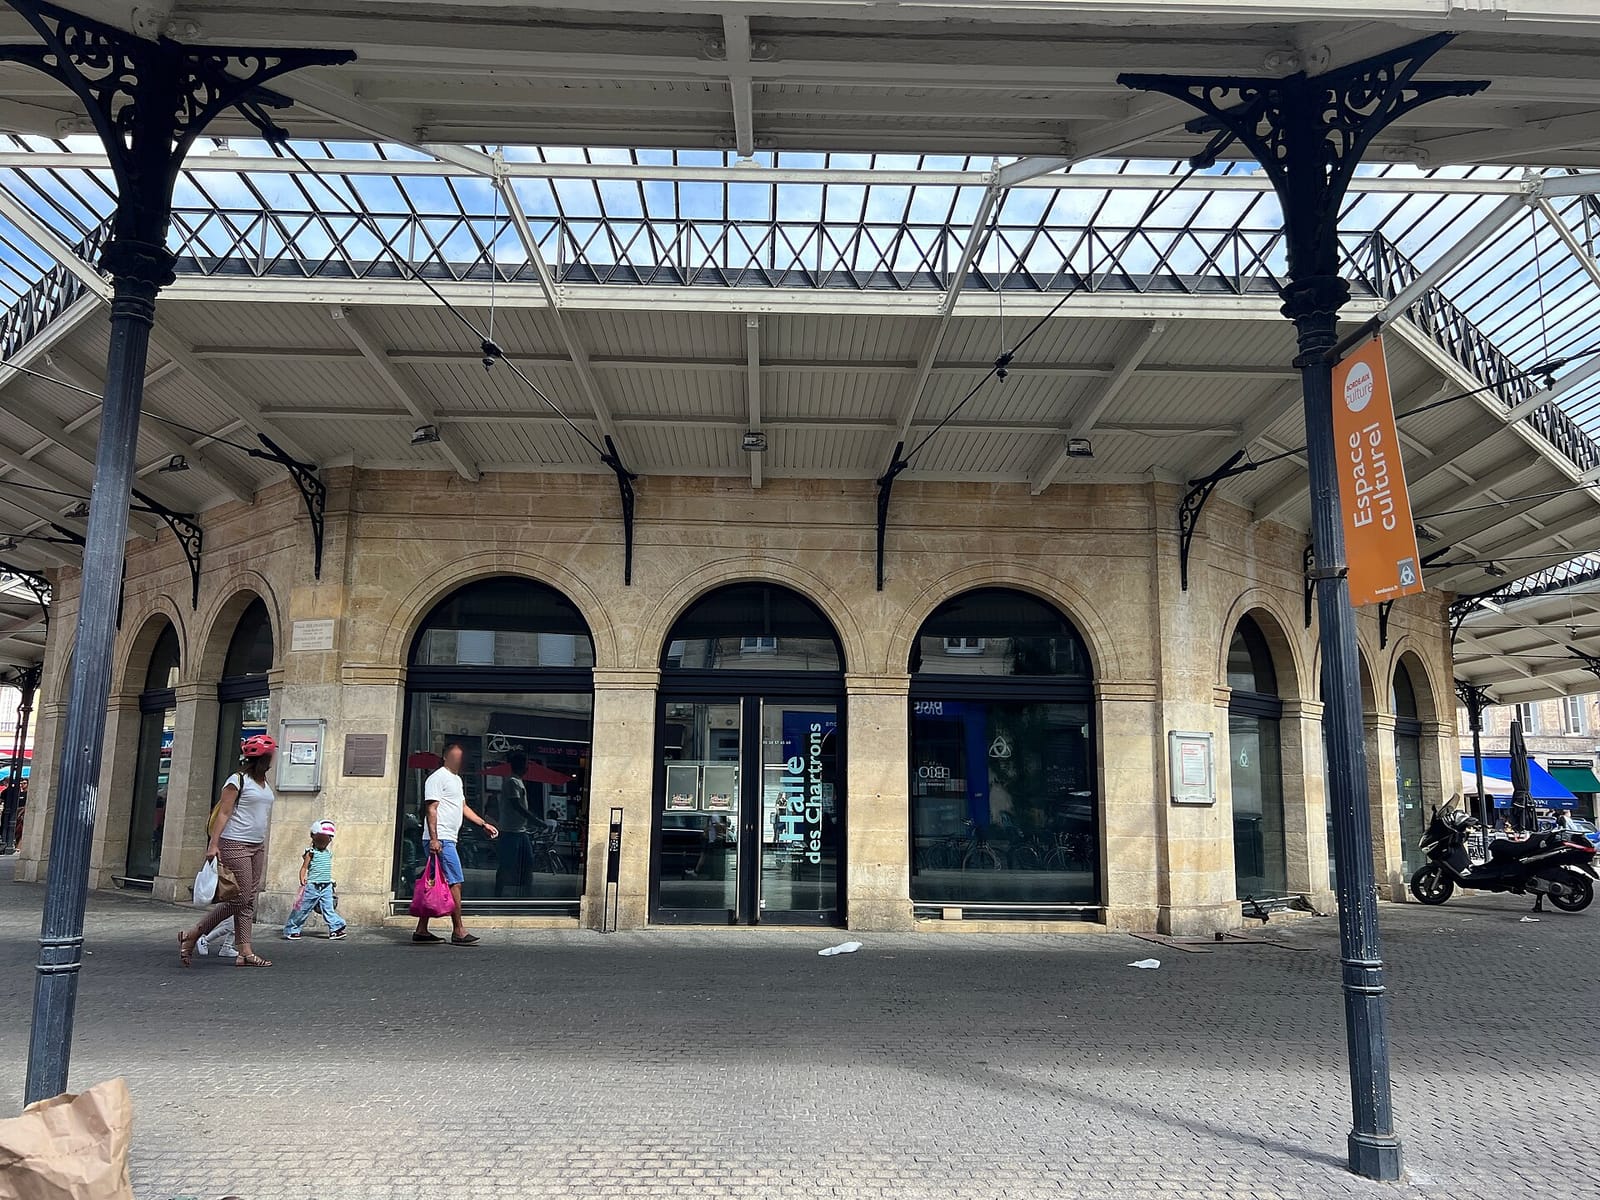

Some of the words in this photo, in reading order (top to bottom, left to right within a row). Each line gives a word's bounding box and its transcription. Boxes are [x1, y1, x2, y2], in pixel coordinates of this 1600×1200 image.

[1346, 373, 1370, 392] BORDEAUX
[1346, 383, 1374, 406] culture
[1349, 431, 1374, 528] Espace
[1362, 422, 1396, 530] culturel
[779, 756, 805, 842] Halle
[805, 723, 822, 824] Chartrons
[805, 830, 822, 864] des
